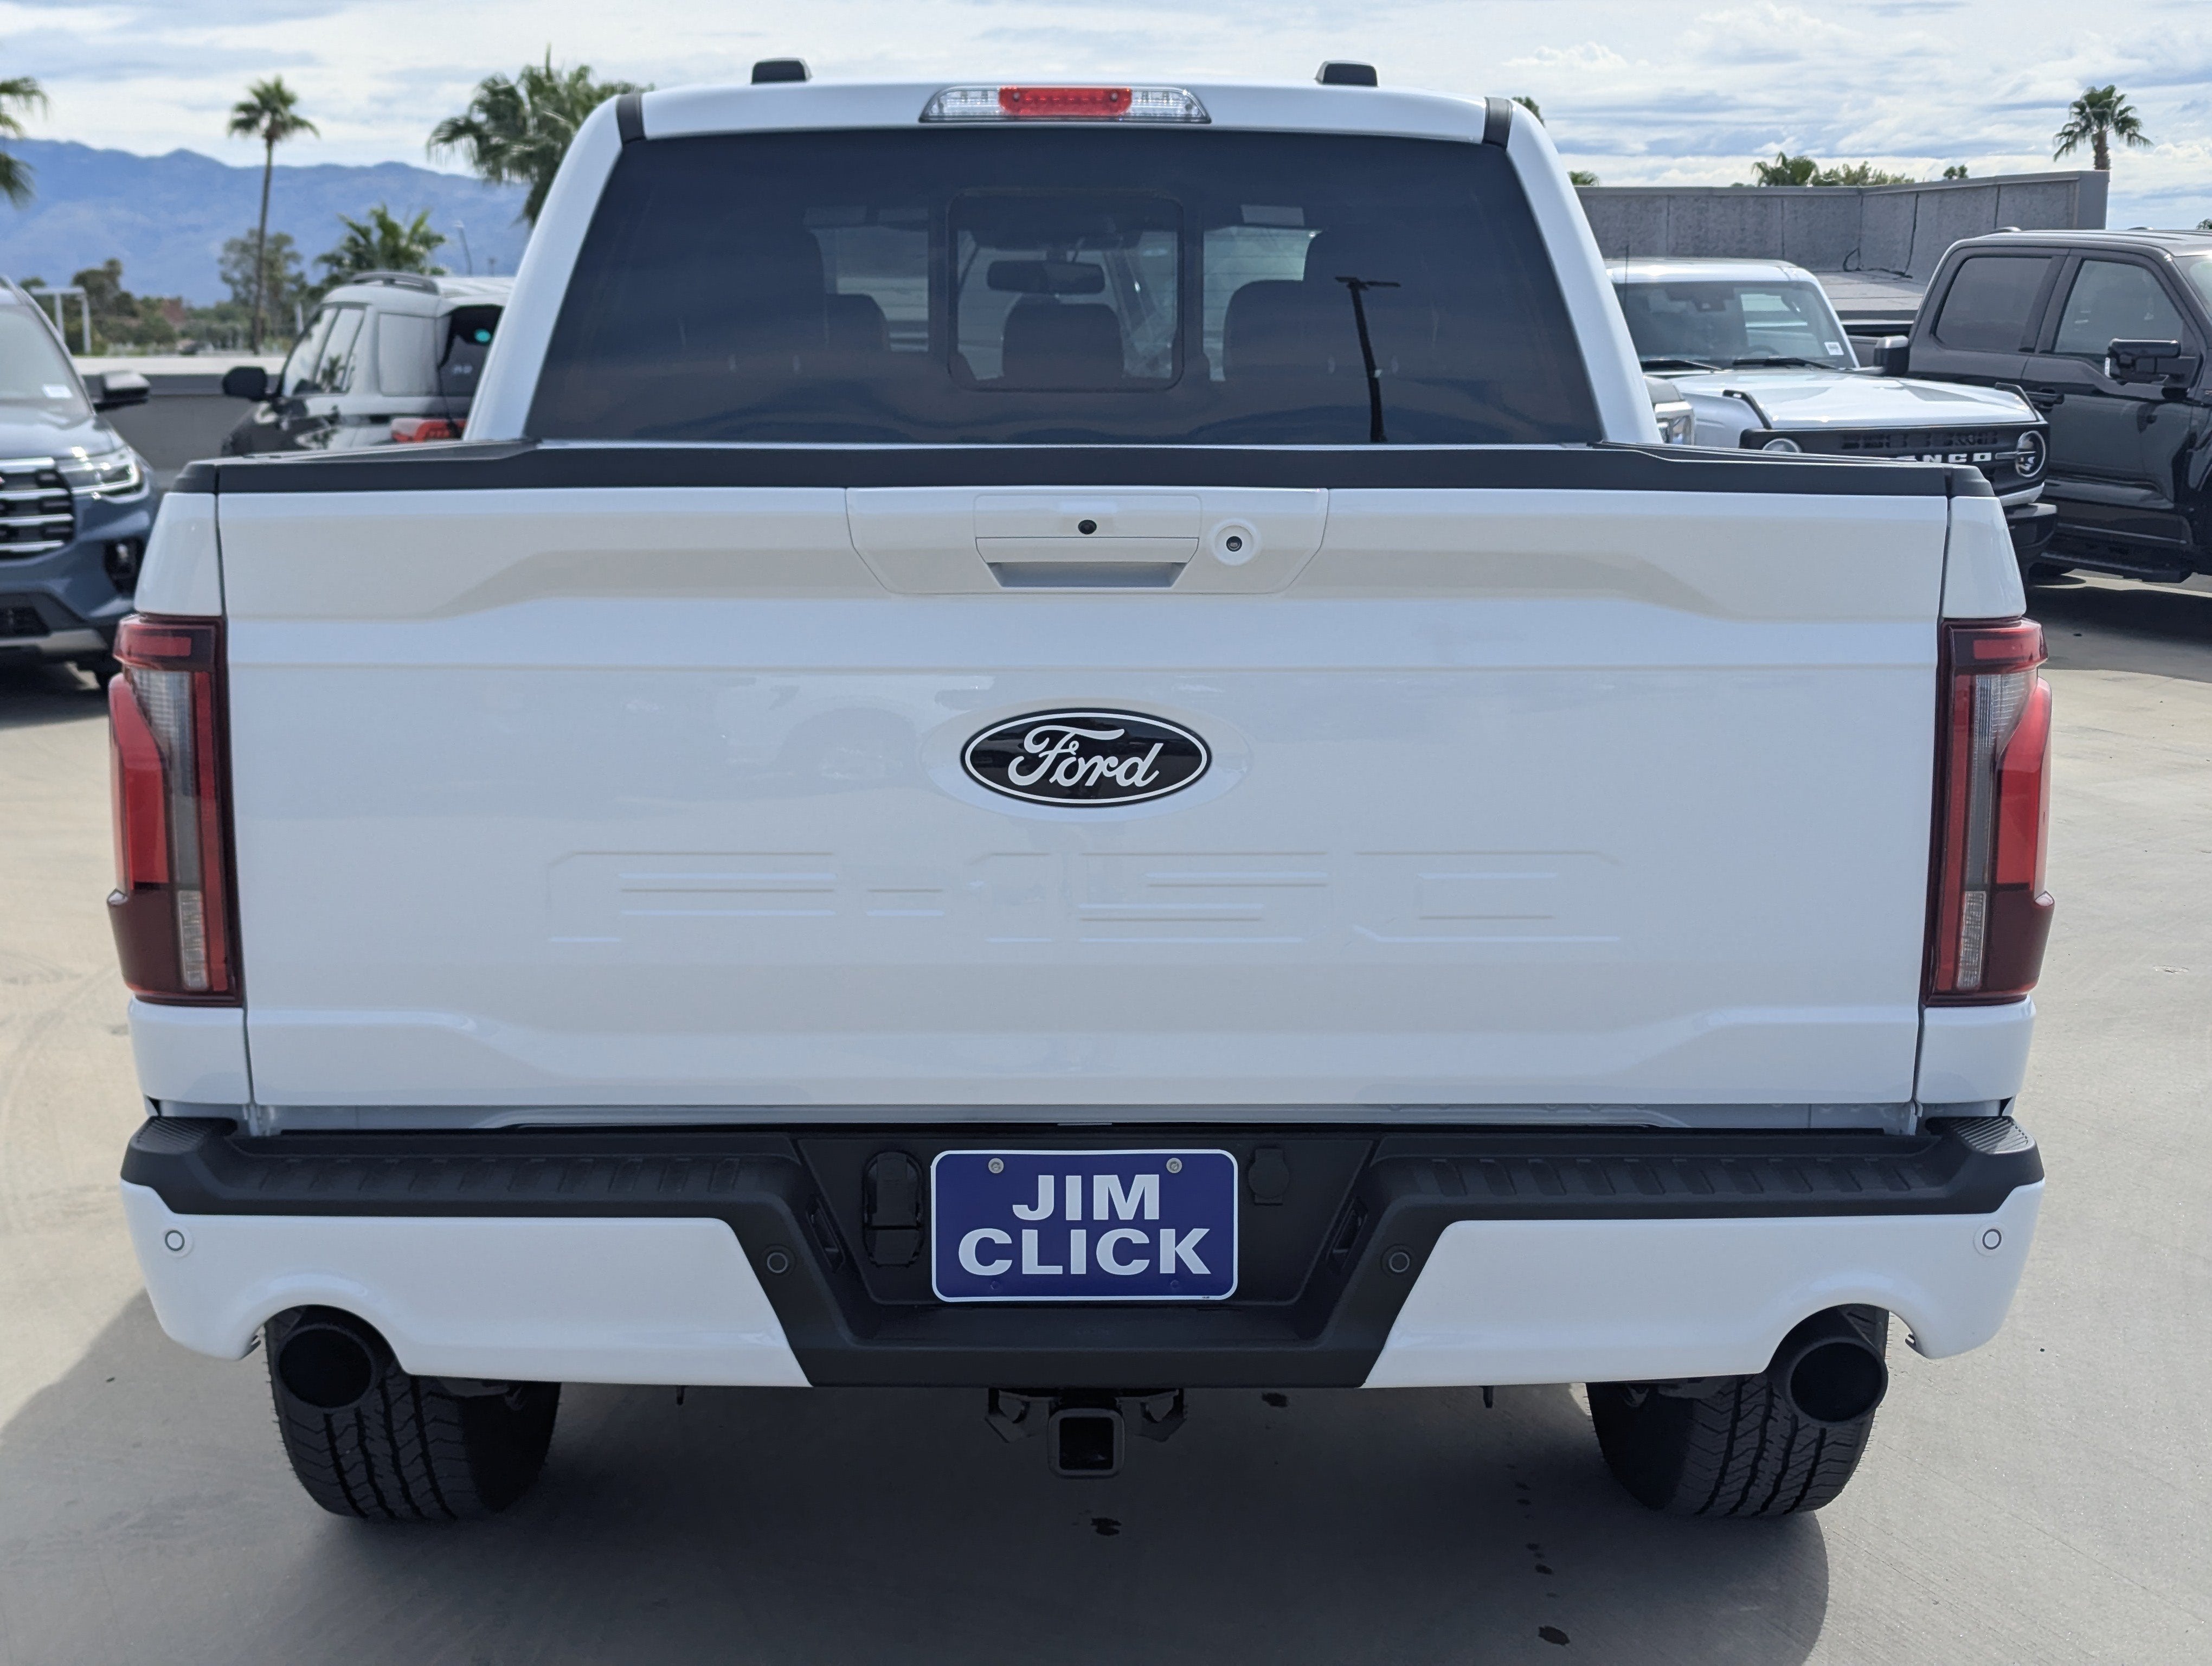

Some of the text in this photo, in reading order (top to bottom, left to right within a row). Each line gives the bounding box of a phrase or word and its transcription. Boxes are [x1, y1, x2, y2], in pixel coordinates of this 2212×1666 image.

[1008, 725, 1164, 787] Ford
[1012, 1174, 1160, 1221] JIM
[958, 1228, 1211, 1276] CLICK
